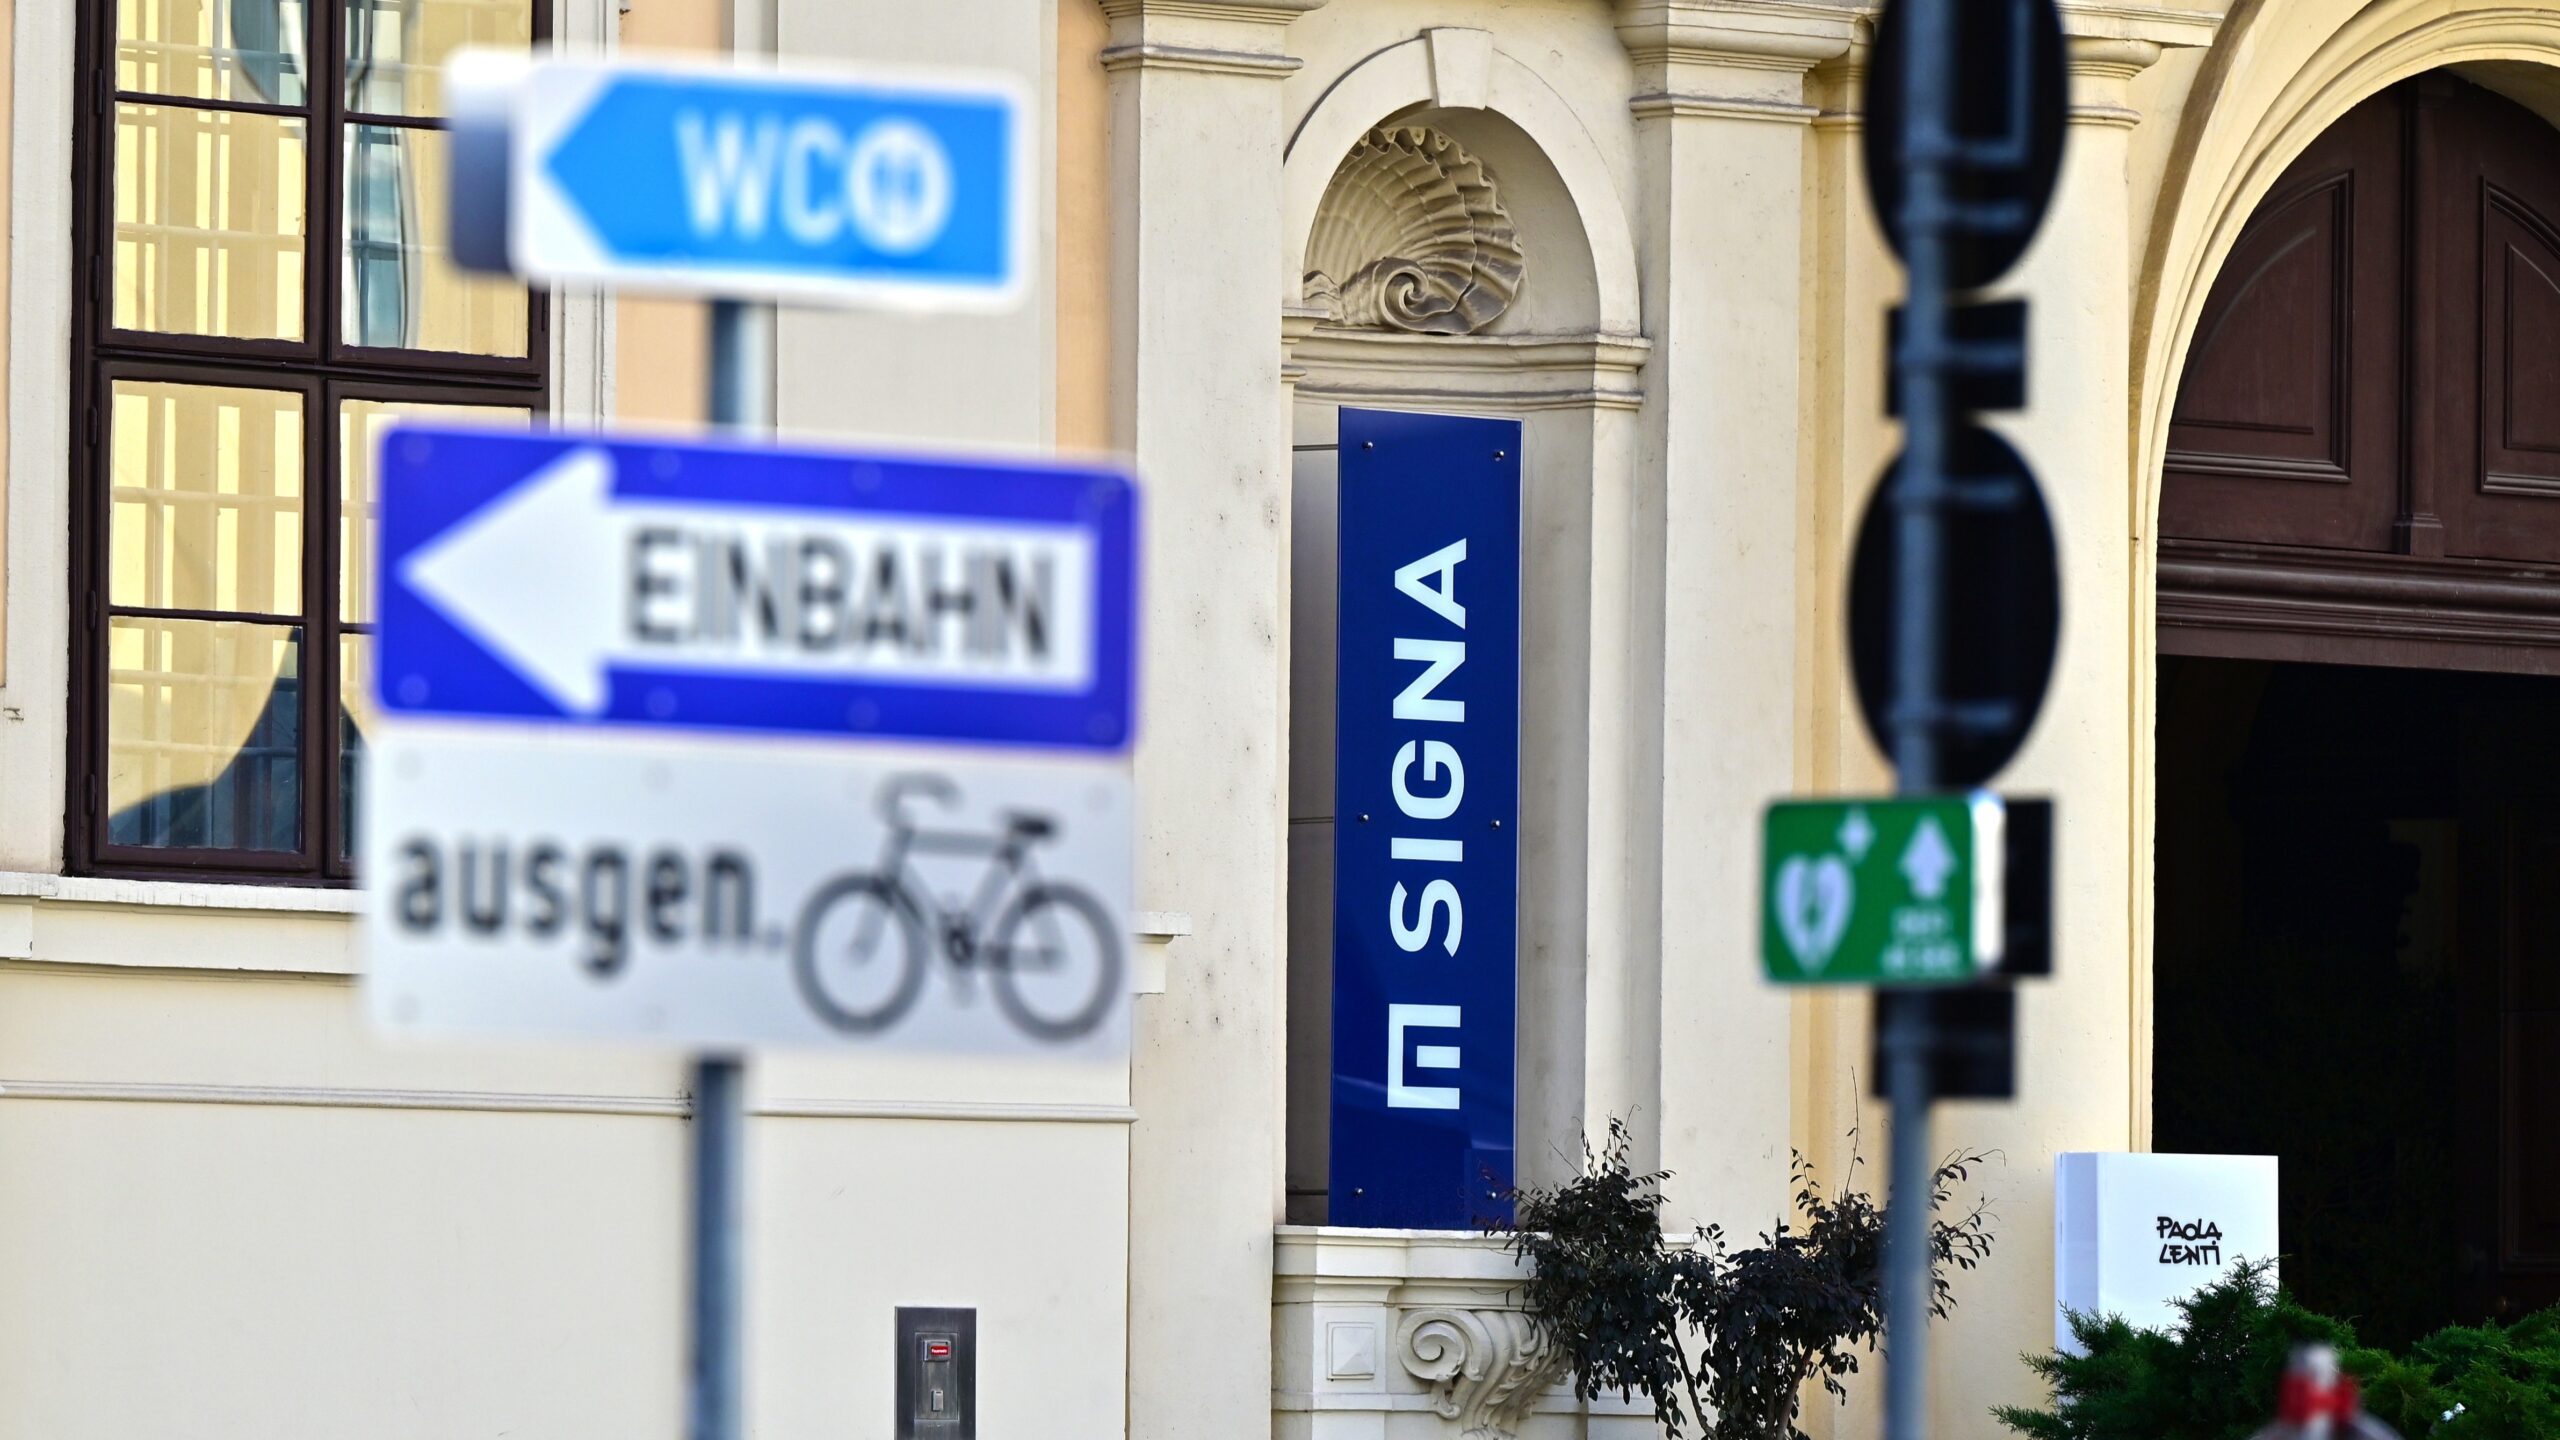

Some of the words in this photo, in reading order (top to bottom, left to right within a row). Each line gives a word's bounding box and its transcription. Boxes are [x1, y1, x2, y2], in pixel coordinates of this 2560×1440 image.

[675, 110, 846, 243] WC
[628, 525, 1056, 661] EINBAHN
[1389, 537, 1467, 957] SIGNA
[395, 832, 786, 976] ausgen.
[2156, 1216, 2222, 1240] PAOLA
